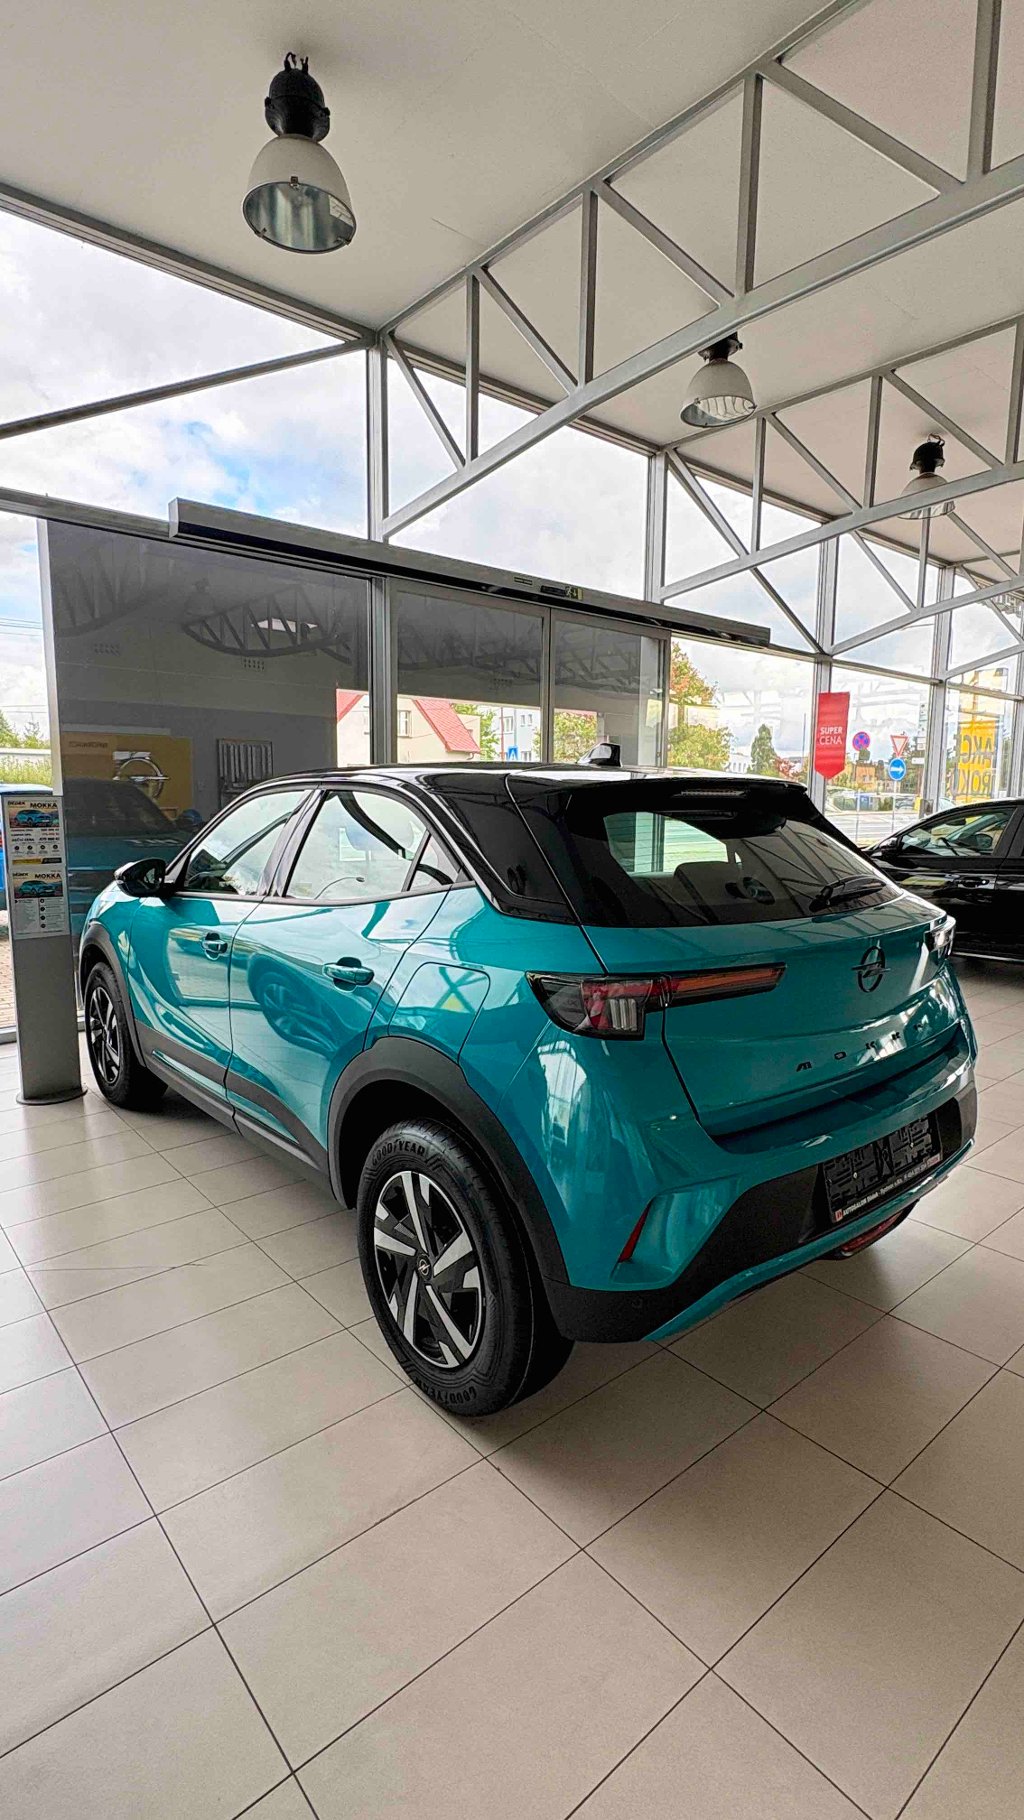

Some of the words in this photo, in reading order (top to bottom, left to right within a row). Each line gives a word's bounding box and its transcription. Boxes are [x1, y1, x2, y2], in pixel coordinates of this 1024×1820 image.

[820, 726, 843, 735] SUPER
[819, 735, 843, 745] CENA
[796, 1023, 926, 1072] MOKKA
[372, 1139, 426, 1166] GOODYEAR
